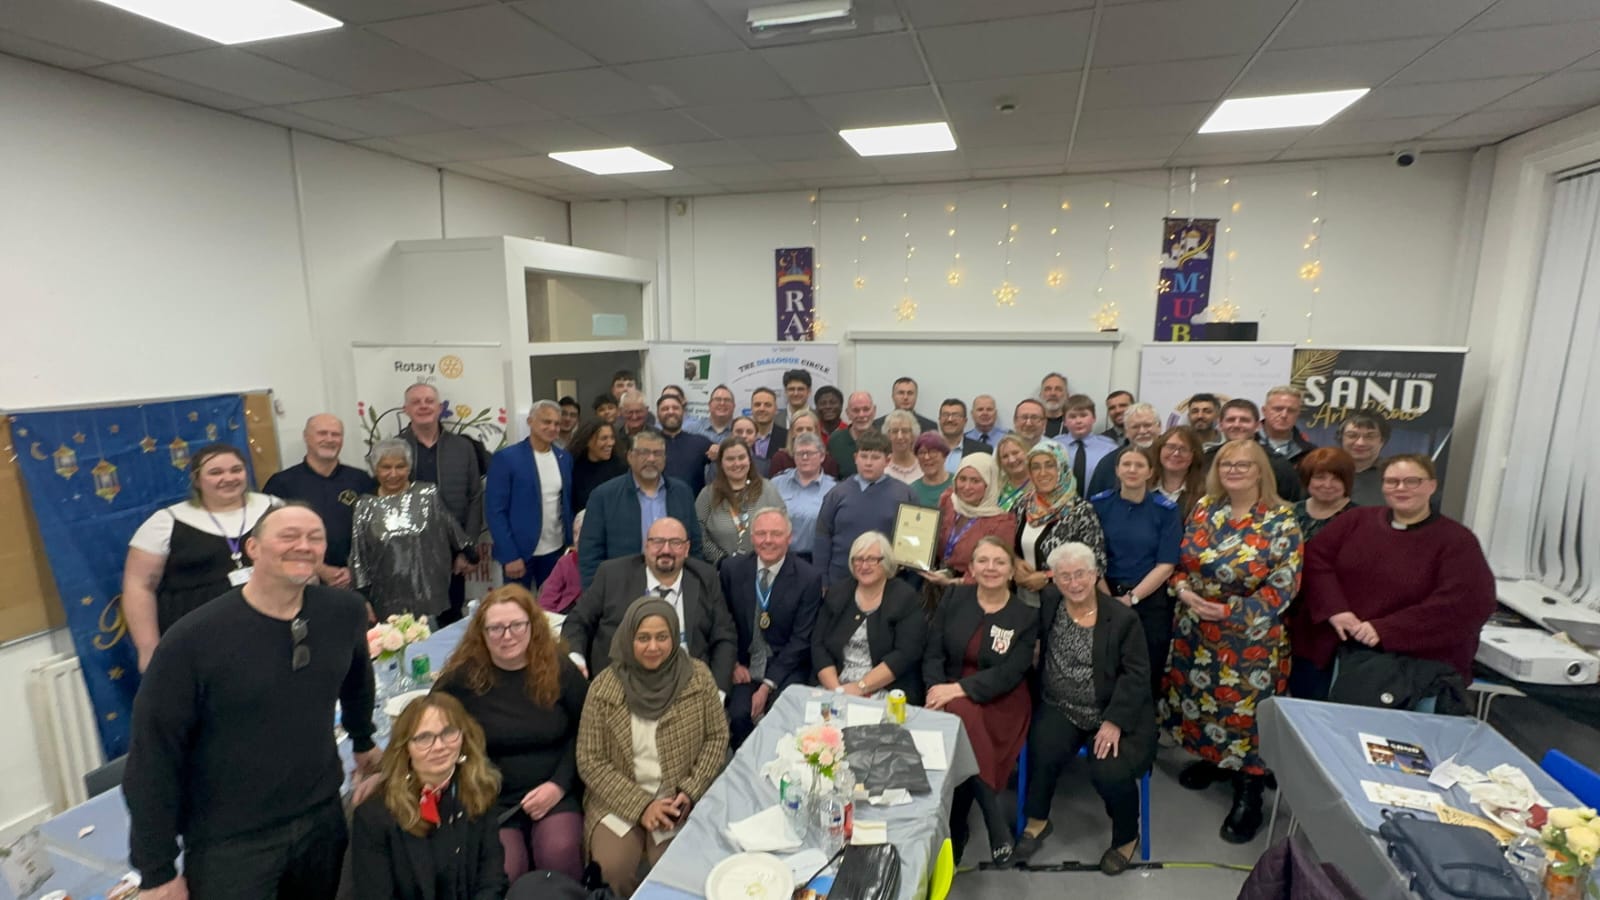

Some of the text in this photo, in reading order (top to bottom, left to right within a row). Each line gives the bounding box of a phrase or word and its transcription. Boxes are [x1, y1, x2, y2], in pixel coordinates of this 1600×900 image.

[394, 360, 436, 374] Rotary
[738, 357, 831, 374] THE DIALOGUE CIRCLE
[1304, 375, 1433, 414] SAND
[1306, 402, 1348, 429] Art
